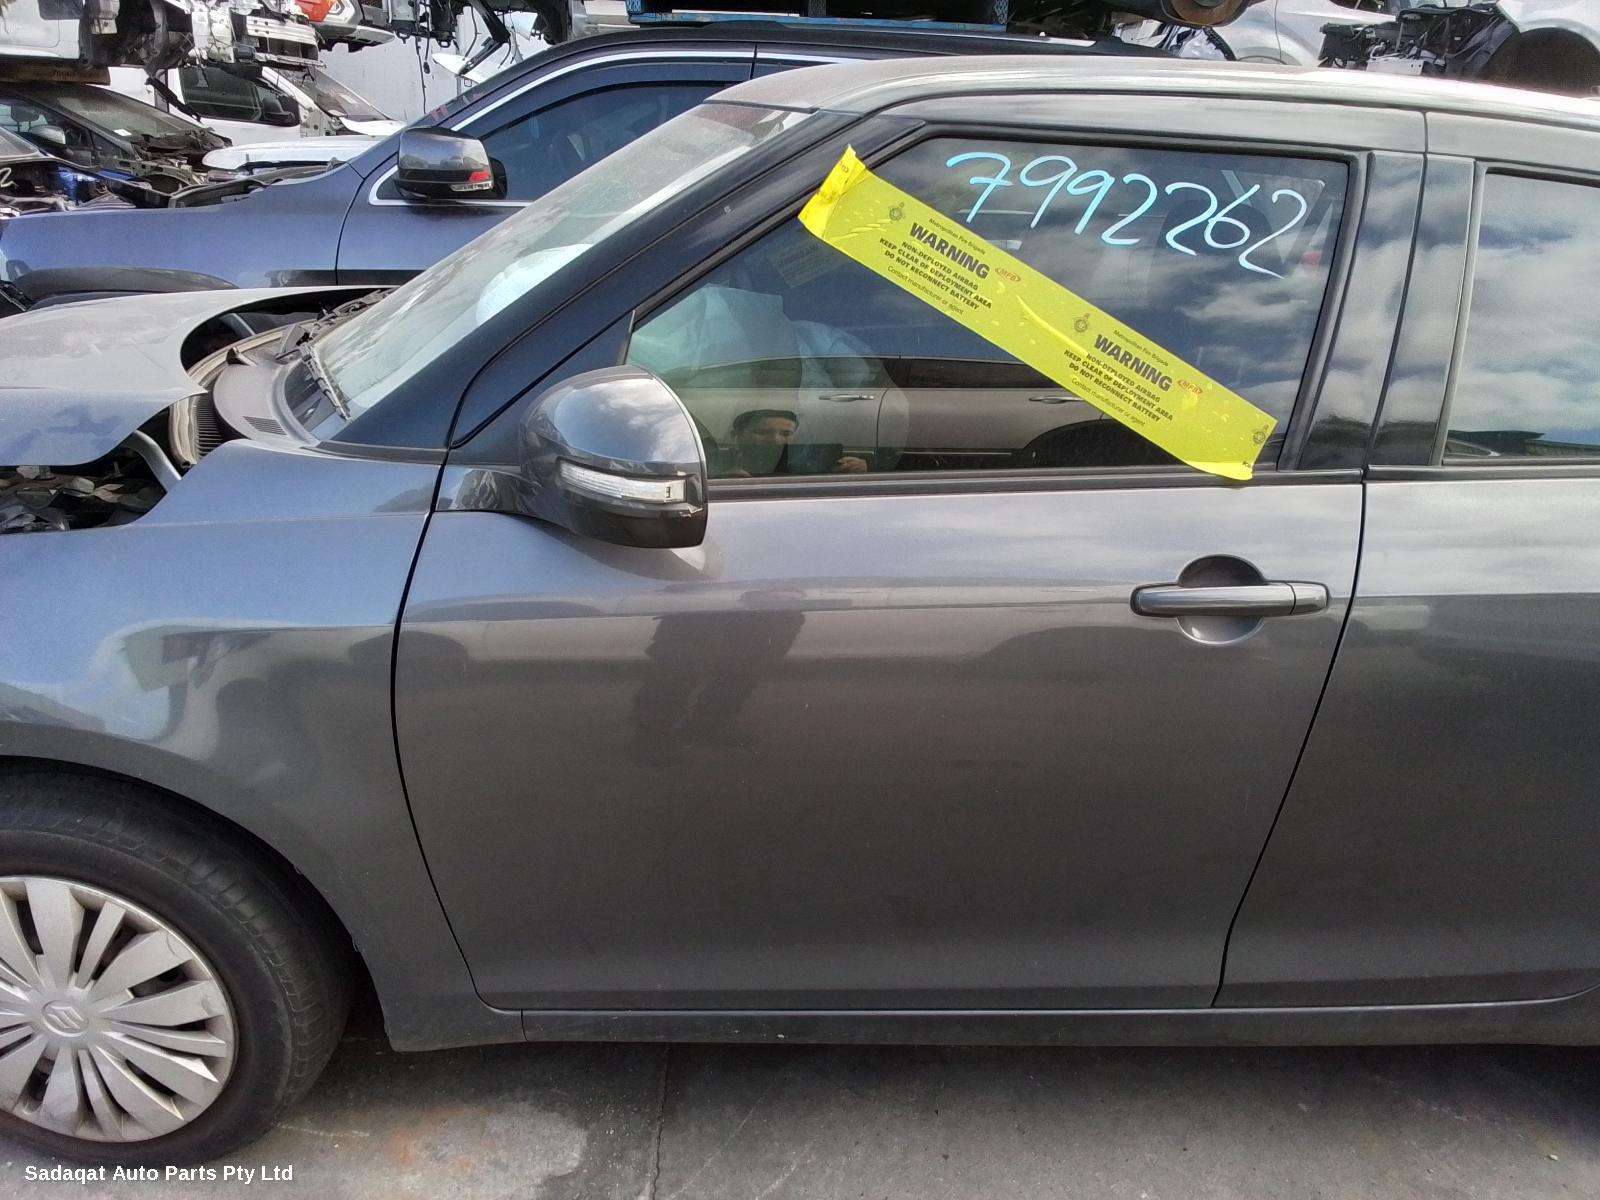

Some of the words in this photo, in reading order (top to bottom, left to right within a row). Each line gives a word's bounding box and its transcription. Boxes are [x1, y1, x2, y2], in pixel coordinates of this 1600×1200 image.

[928, 218, 958, 238] Metropolitan
[957, 236, 968, 244] Fire
[966, 241, 985, 255] Brigade
[946, 151, 1308, 279] 7992262
[879, 237, 897, 251] KEEP
[897, 248, 919, 264] CLEAR
[919, 261, 929, 270] OF
[929, 267, 973, 296] DEPLOYMENT
[973, 294, 992, 308] AREA
[901, 241, 952, 274] NON-DEPLOYED
[952, 272, 978, 290] AIRBAG
[907, 222, 991, 279] WARNING
[884, 250, 895, 259] DO
[895, 257, 909, 268] NOT
[909, 265, 949, 291] RECONNECT
[949, 289, 979, 310] BATTERY
[886, 265, 908, 281] Contact
[907, 277, 942, 301] manufacturer
[947, 302, 963, 315] agent
[1092, 335, 1174, 390] WARNING
[1112, 330, 1142, 350] Metropolitan
[1150, 353, 1169, 367] Brigade
[1063, 349, 1081, 363] KEEP
[1081, 360, 1103, 376] CLEAR
[1103, 374, 1112, 382] OF
[1112, 380, 1155, 408] DEPLOYMENT
[1155, 406, 1174, 420] AREA
[1068, 362, 1079, 371] DO
[1079, 368, 1093, 380] NOT
[1093, 378, 1132, 403] RECONNECT
[1132, 402, 1160, 421] BATTERY
[1071, 377, 1092, 392] Contact
[1090, 390, 1125, 413] manufacturer
[1085, 354, 1135, 386] NON-DEPLOYED
[1135, 384, 1161, 402] AIRBAG
